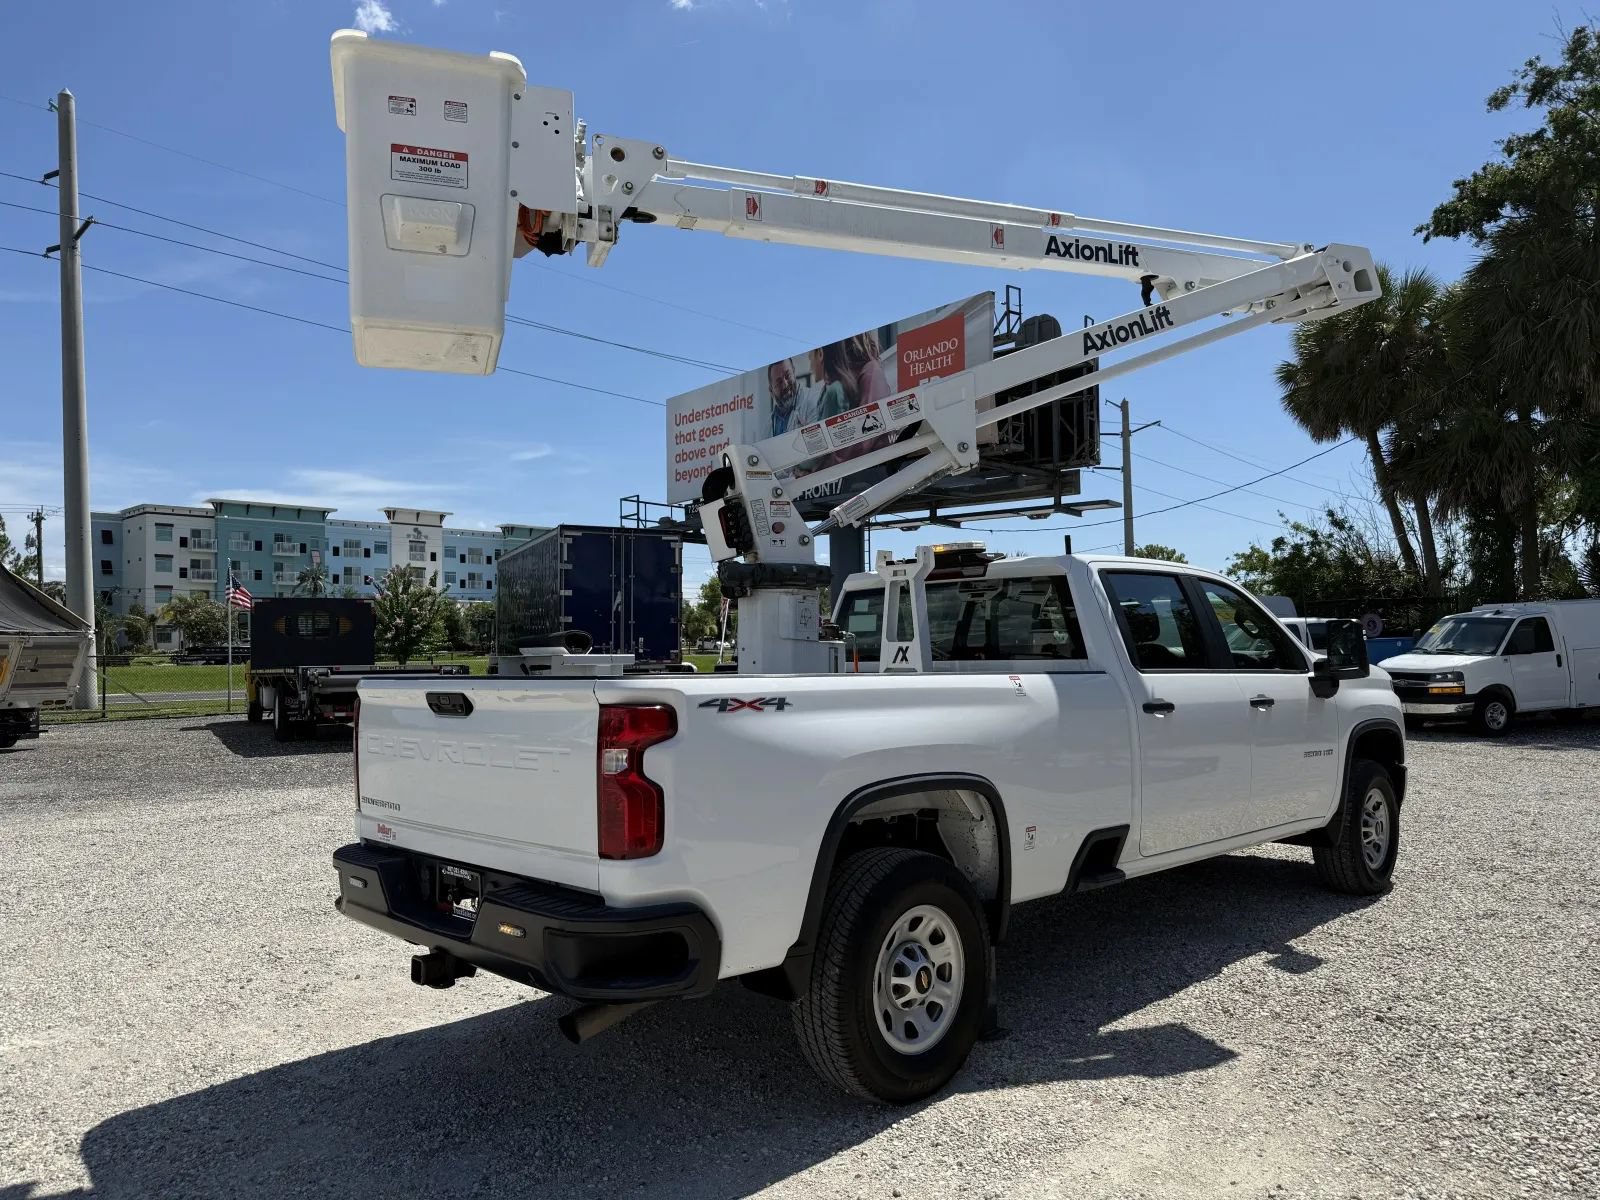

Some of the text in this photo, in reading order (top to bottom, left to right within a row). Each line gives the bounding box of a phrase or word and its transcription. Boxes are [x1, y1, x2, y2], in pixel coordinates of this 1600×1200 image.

[399, 155, 461, 169] MAXIMUM LOAD
[416, 148, 455, 159] DANGER
[1044, 235, 1139, 267] AxionLift
[1082, 305, 1174, 356] AxionLift
[903, 337, 959, 364] ORLANDO
[910, 354, 953, 377] HEALTH
[674, 393, 754, 428] Understanding
[843, 407, 869, 421] DANGER
[674, 423, 724, 446] that goes
[674, 437, 730, 464] above and
[674, 461, 713, 483] beyond
[366, 733, 572, 773] CHEVROLET
